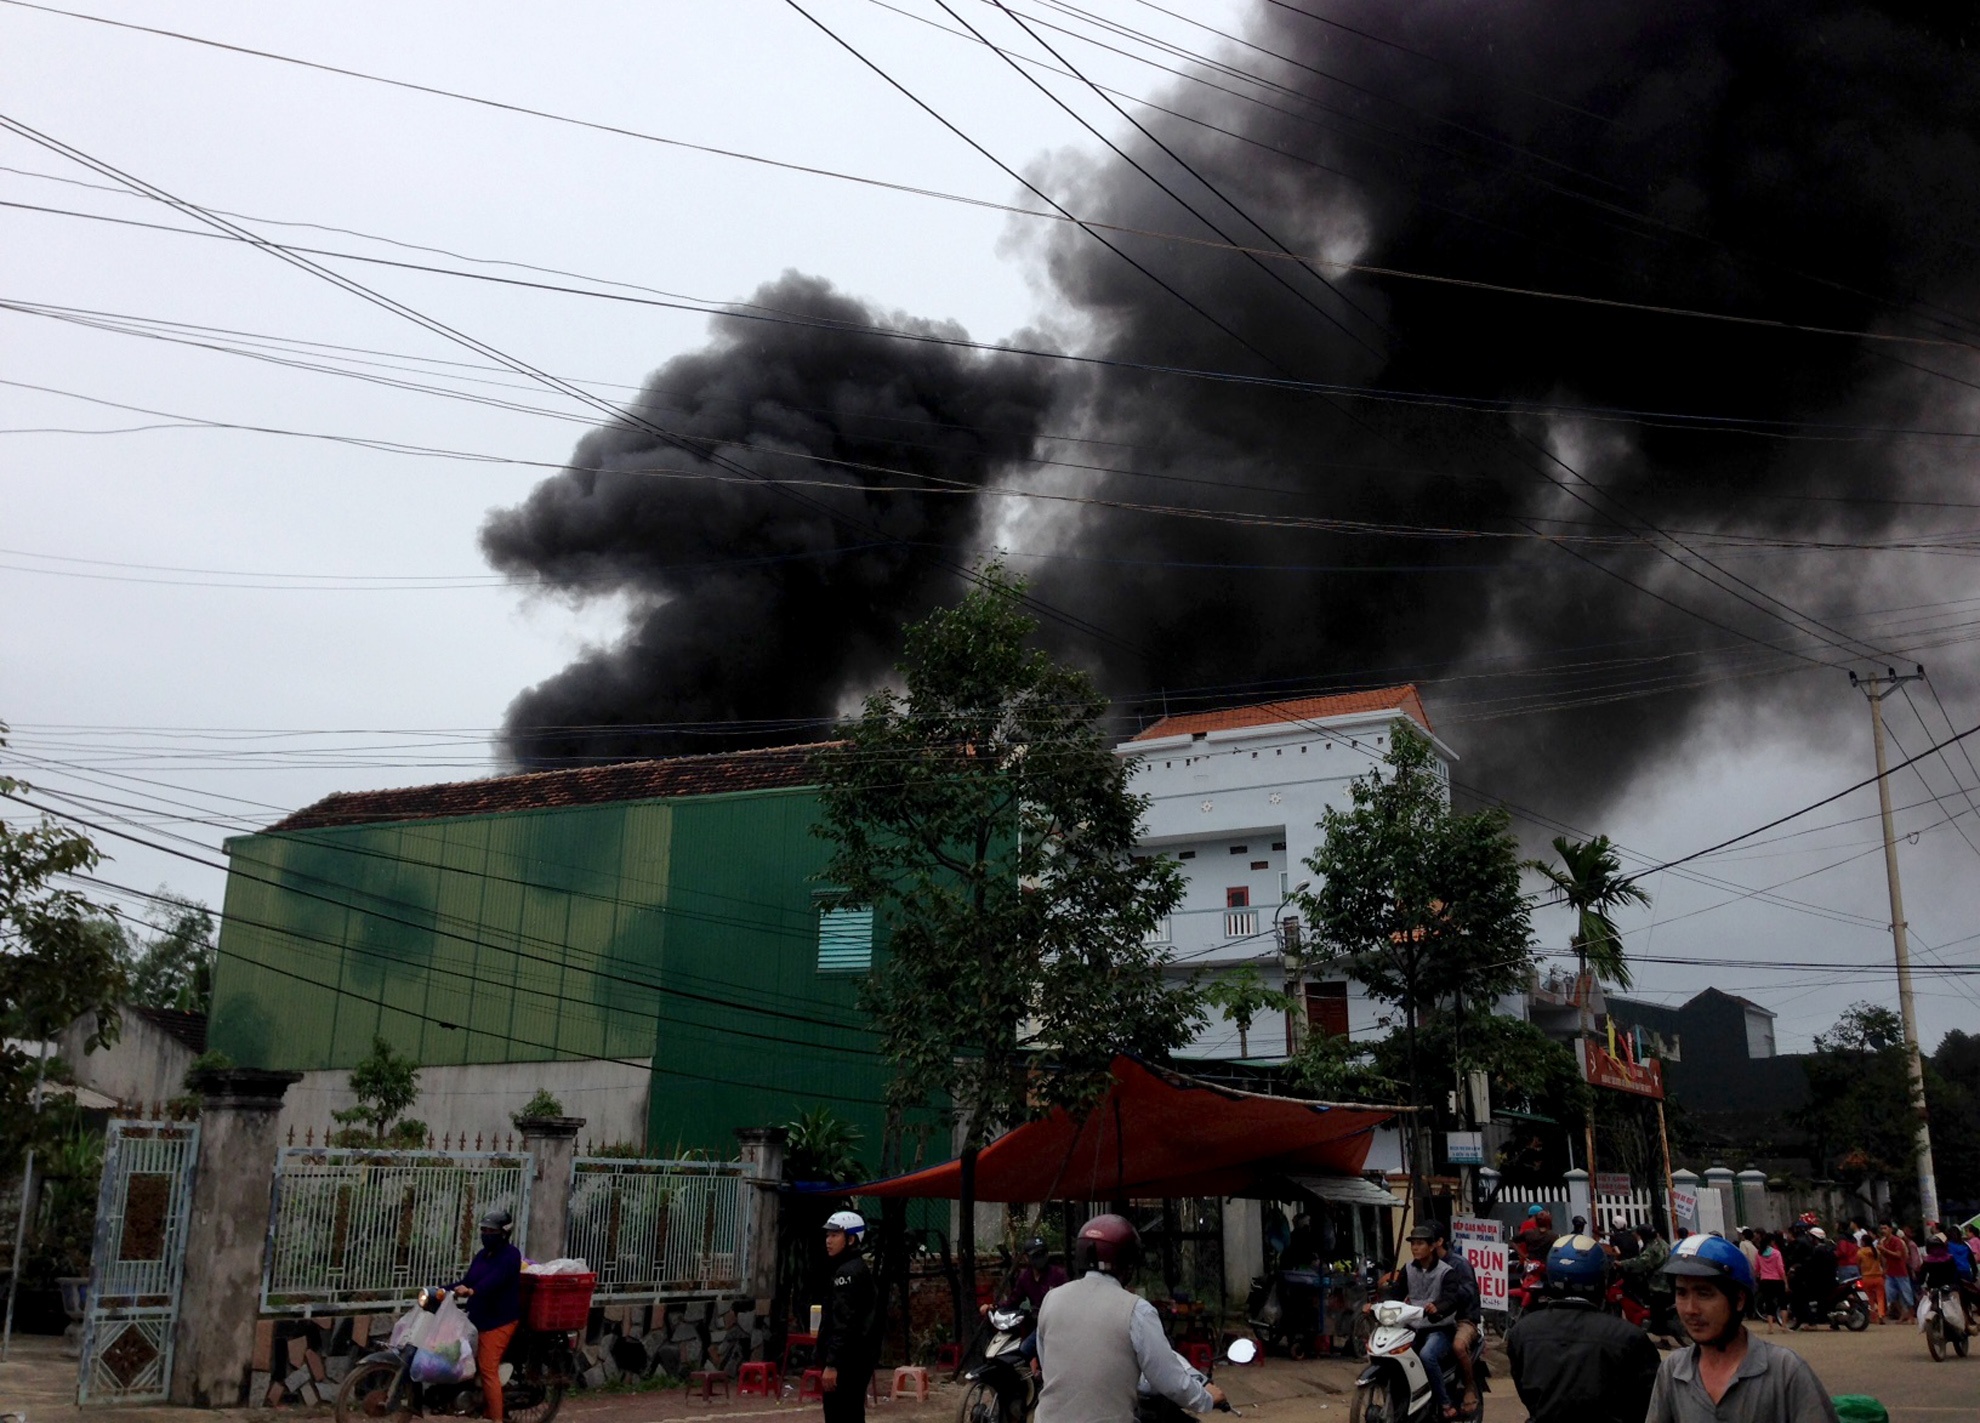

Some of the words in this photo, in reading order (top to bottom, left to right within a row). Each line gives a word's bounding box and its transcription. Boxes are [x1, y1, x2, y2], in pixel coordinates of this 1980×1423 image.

[1453, 1219, 1464, 1231] BẾP
[1464, 1222, 1476, 1232] GAS
[1468, 1245, 1503, 1272] BÚN
[1477, 1271, 1506, 1298] IÊU
